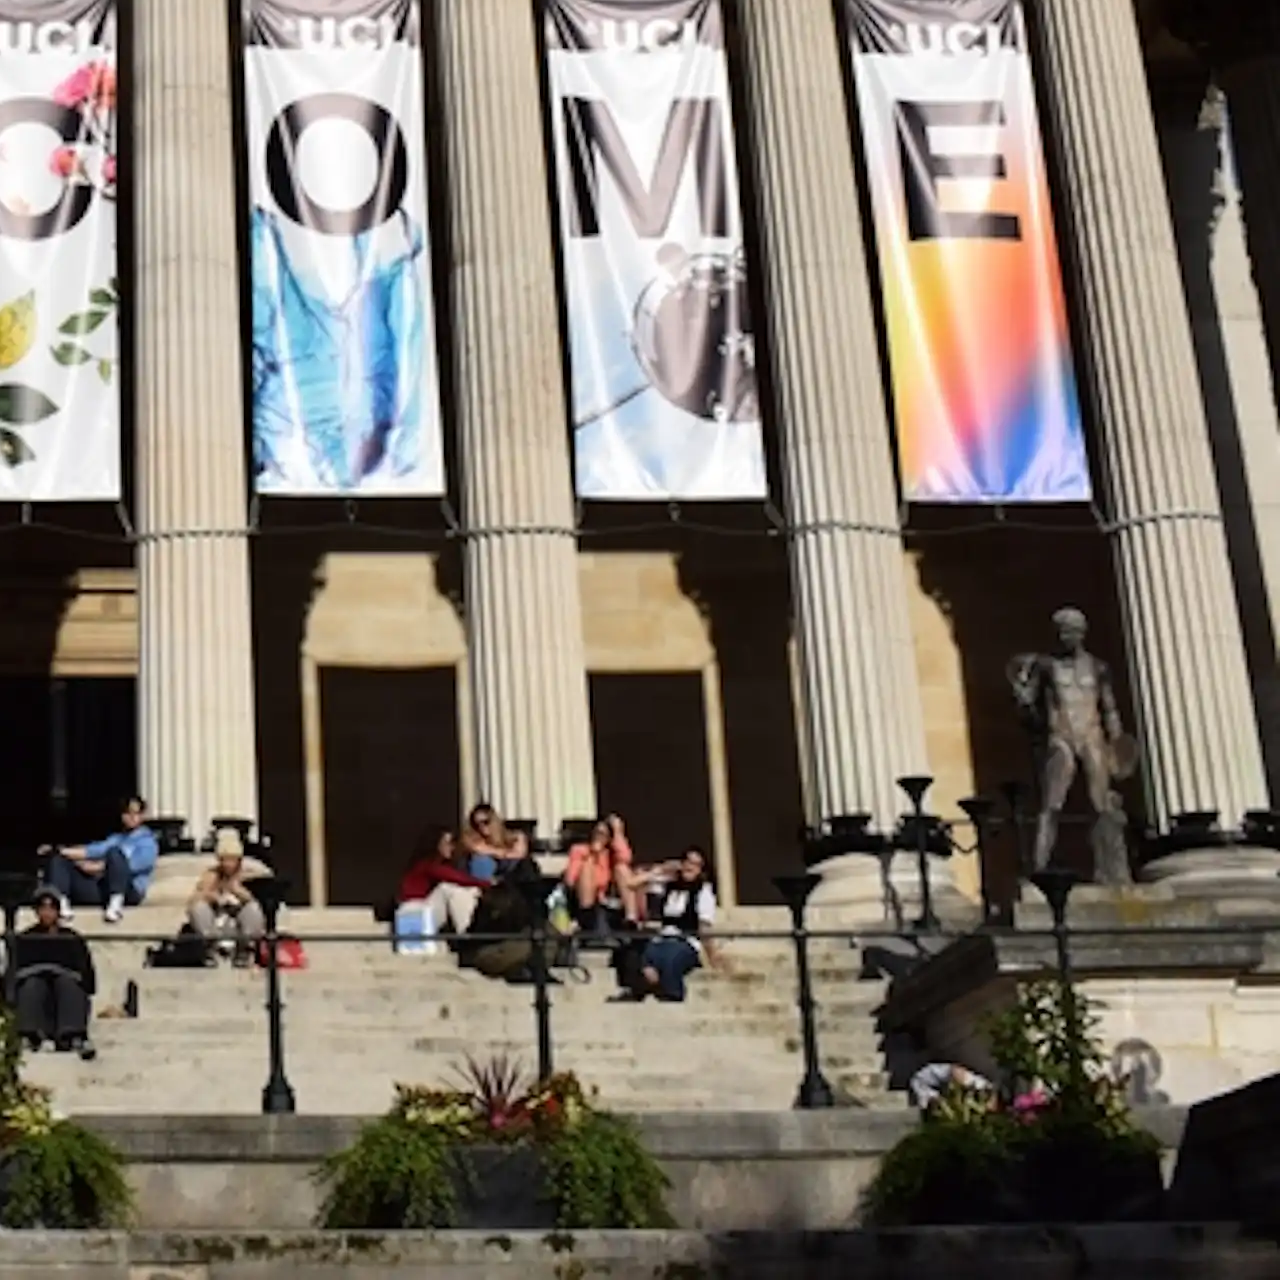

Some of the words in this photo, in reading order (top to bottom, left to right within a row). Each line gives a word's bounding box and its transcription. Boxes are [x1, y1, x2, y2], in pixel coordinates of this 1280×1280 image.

[906, 21, 1014, 56] UCL
[266, 93, 407, 236] O
[561, 97, 729, 238] M
[895, 100, 1021, 242] E
